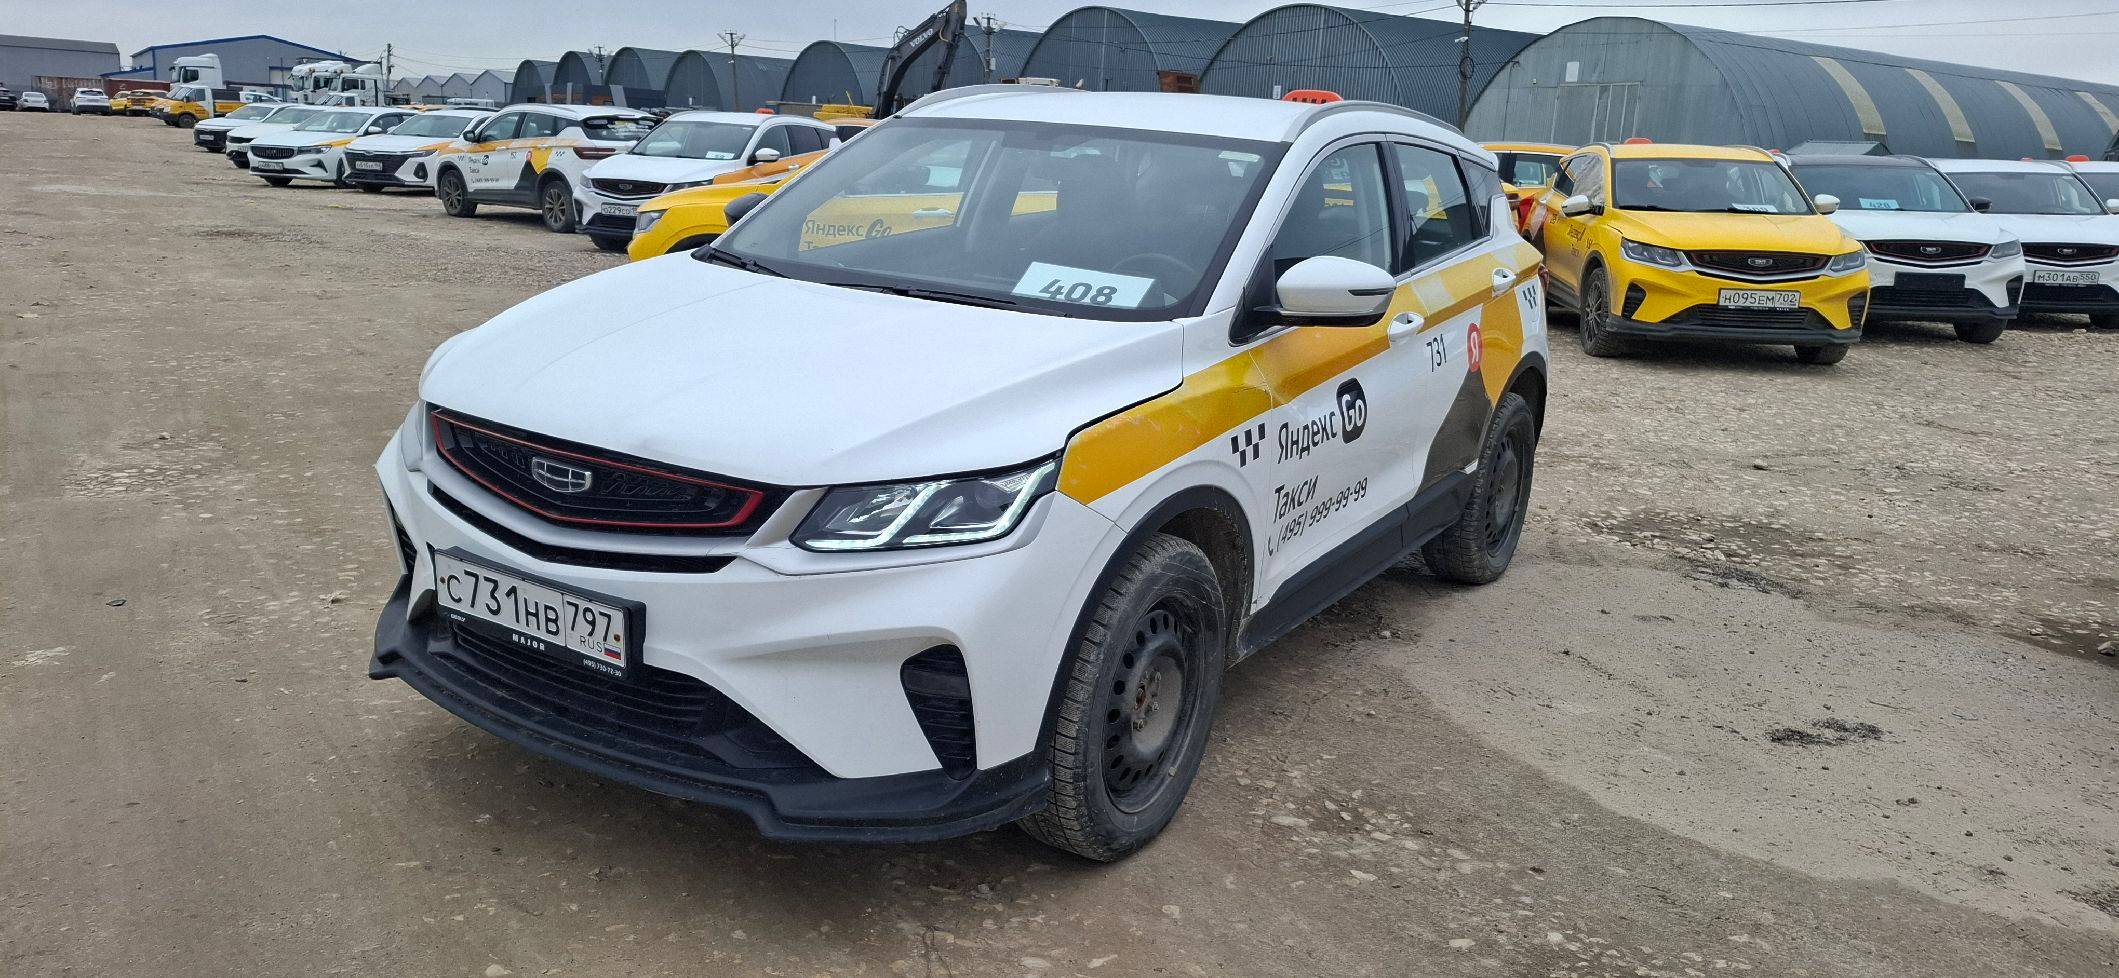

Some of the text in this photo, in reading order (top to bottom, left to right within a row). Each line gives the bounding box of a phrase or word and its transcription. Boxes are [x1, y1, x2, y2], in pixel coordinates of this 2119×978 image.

[909, 28, 933, 47] VOLVO
[805, 220, 864, 238] Яндекс
[2038, 272, 2078, 283] М301АВ
[1039, 279, 1118, 305] 408
[1724, 292, 1796, 305] Н095ЕМ 702
[1426, 334, 1447, 373] 731
[1278, 412, 1338, 464] Яндекс
[1274, 475, 1319, 524] Такси
[1276, 477, 1368, 552] (495) 999-99-99
[447, 569, 612, 642] С731НВ 797
[512, 633, 545, 651] MAJOR
[580, 635, 603, 653] RUS
